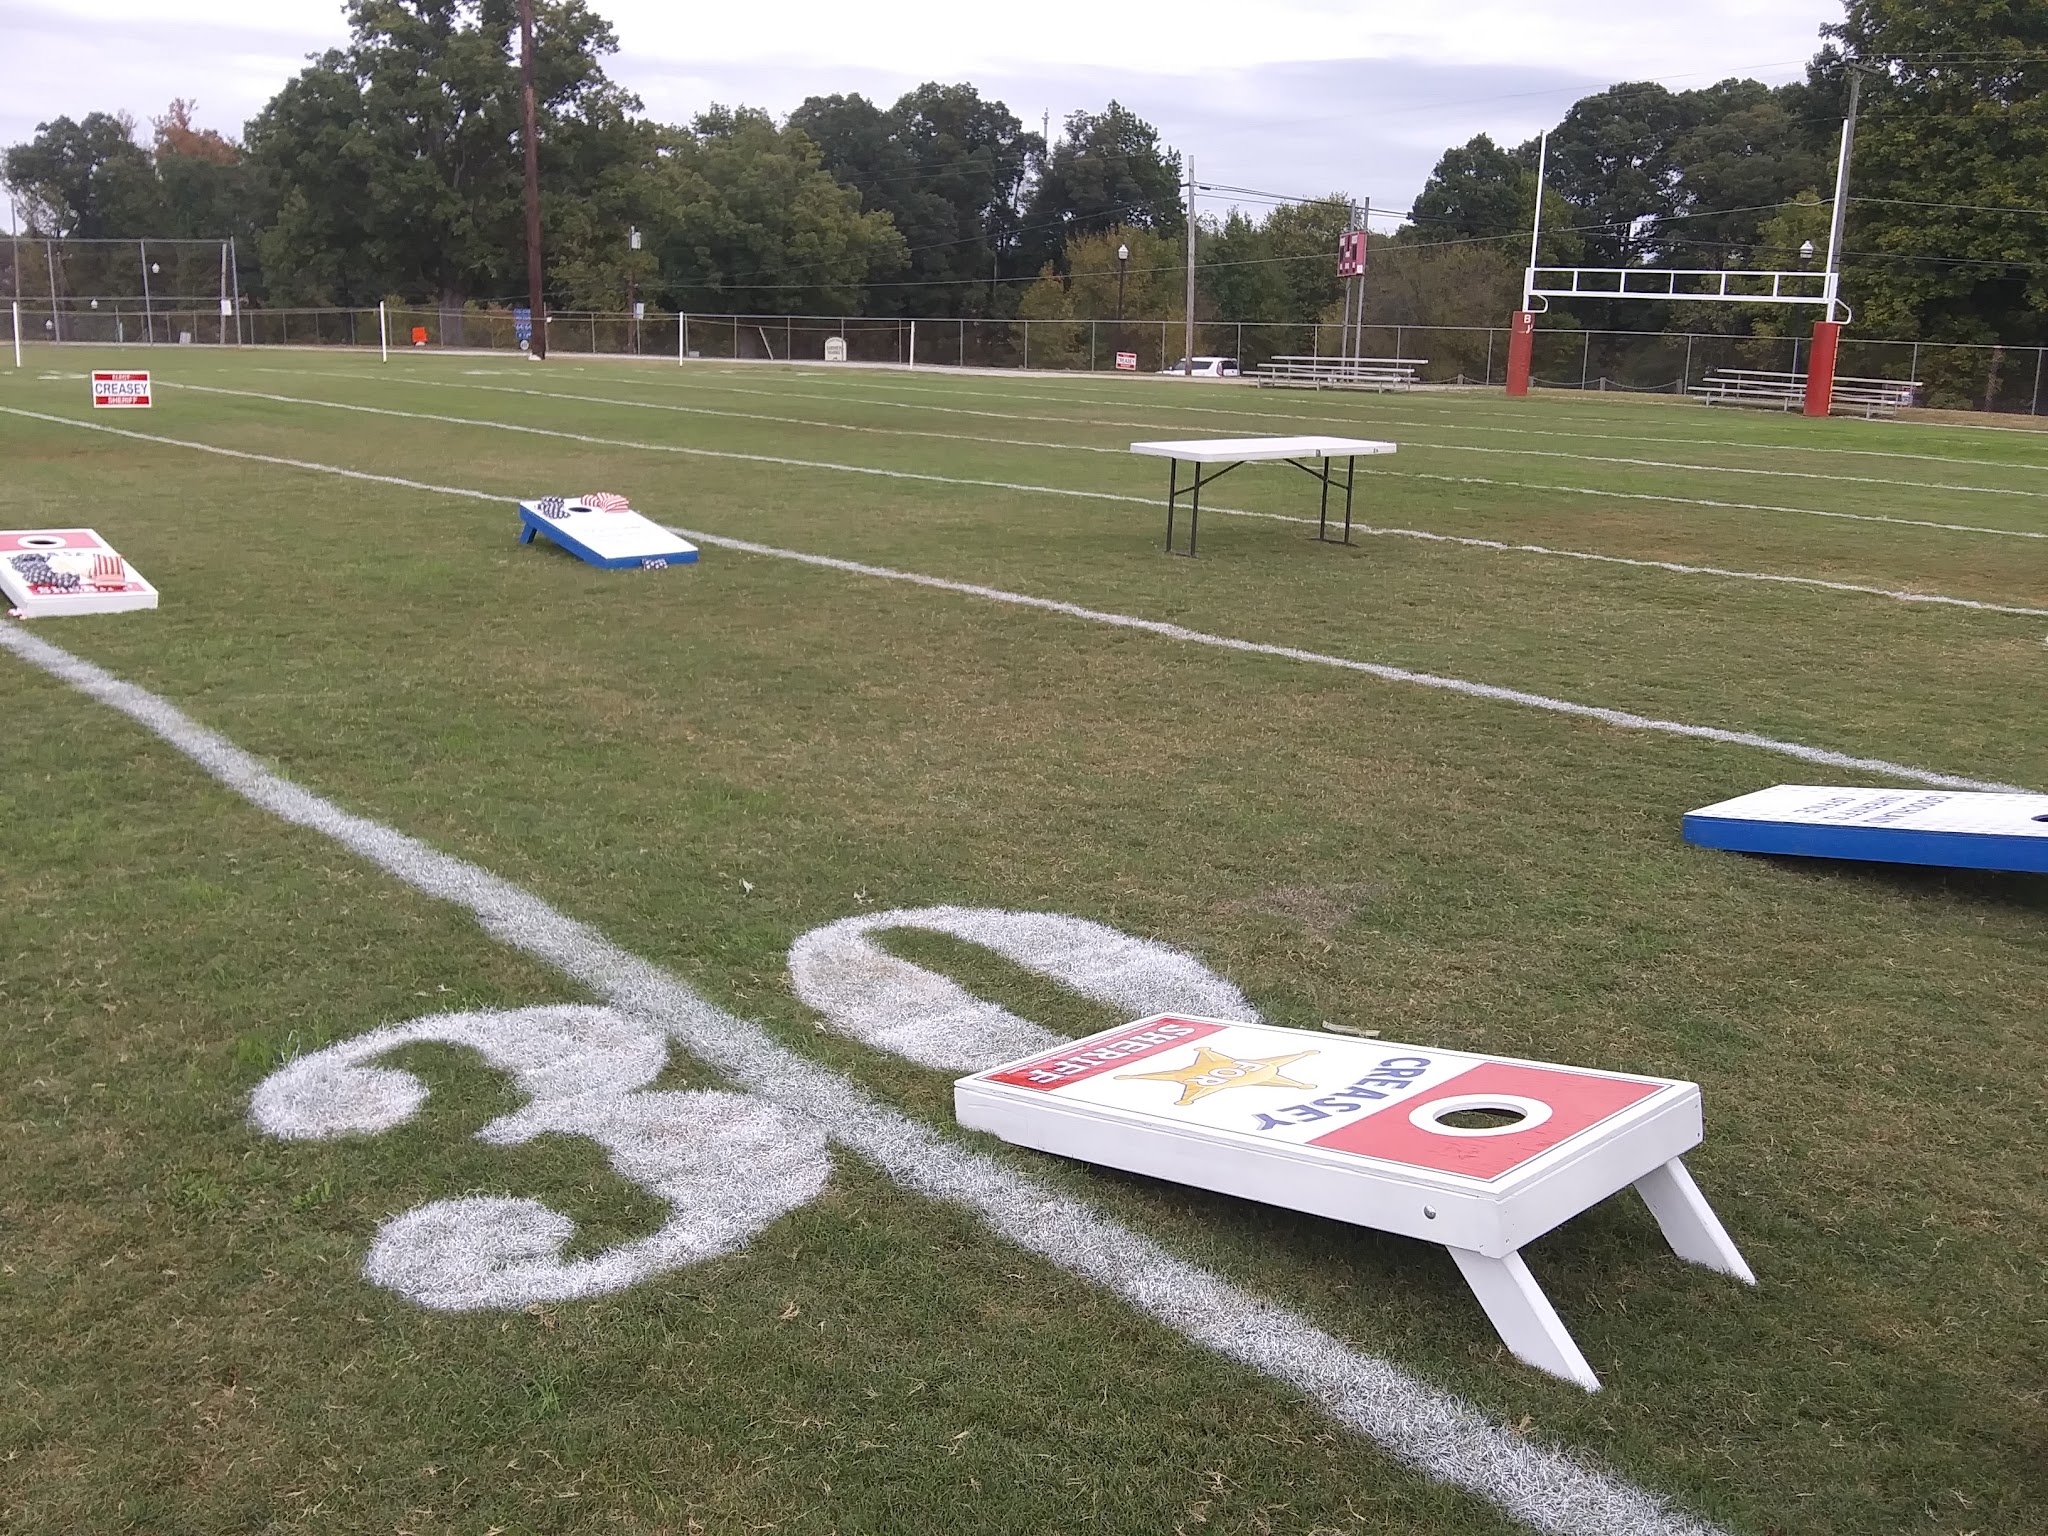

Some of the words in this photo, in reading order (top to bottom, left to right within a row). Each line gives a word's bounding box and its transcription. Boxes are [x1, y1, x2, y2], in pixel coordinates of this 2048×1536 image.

[95, 382, 148, 395] CREASEY
[108, 396, 138, 405] SHERIFF
[1792, 796, 1857, 814] OFFICE
[1027, 1023, 1197, 1085] SHERIFF
[1183, 1060, 1270, 1087] FOR
[1251, 1056, 1432, 1132] CREASEY
